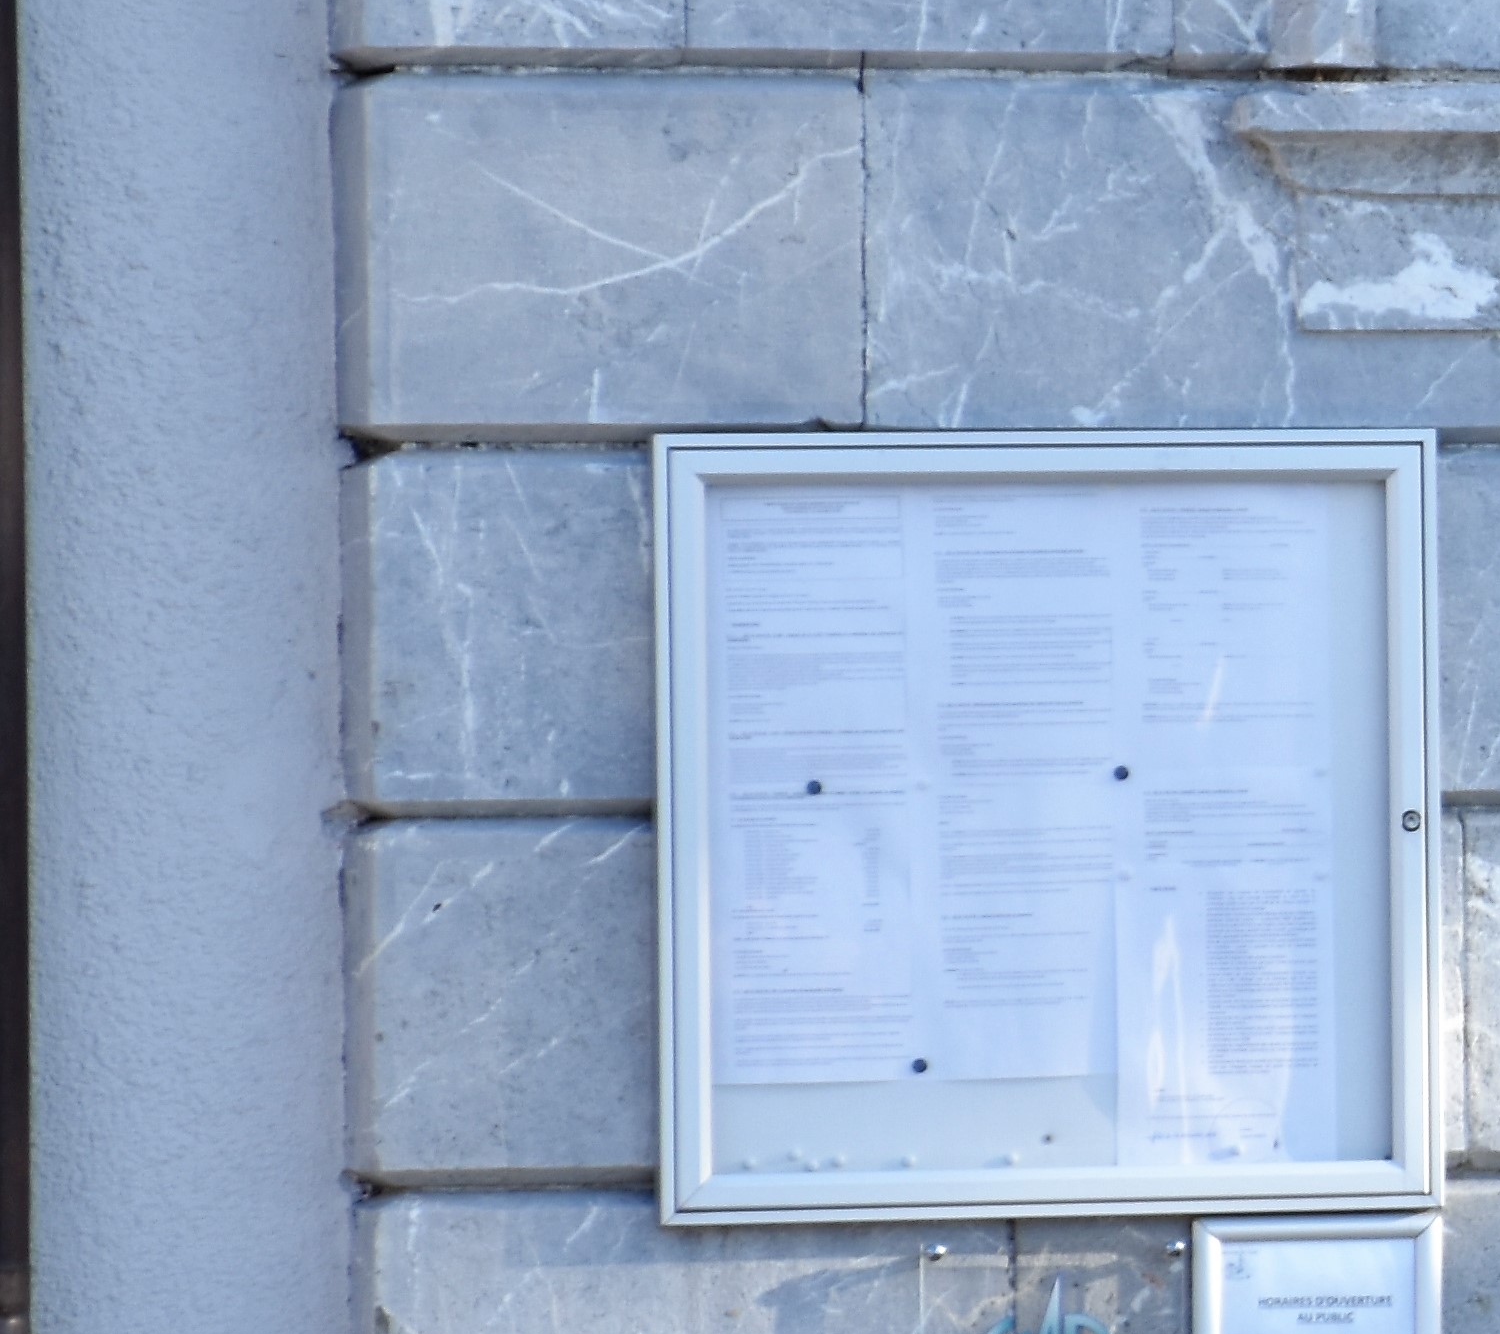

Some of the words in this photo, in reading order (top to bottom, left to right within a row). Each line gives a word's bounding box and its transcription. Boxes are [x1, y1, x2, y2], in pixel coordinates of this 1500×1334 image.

[1258, 1296, 1312, 1308] HORAIRES
[1315, 1295, 1393, 1308] D'OUVERTURE
[1297, 1313, 1313, 1323] AU
[1315, 1312, 1354, 1323] PUBLIC
